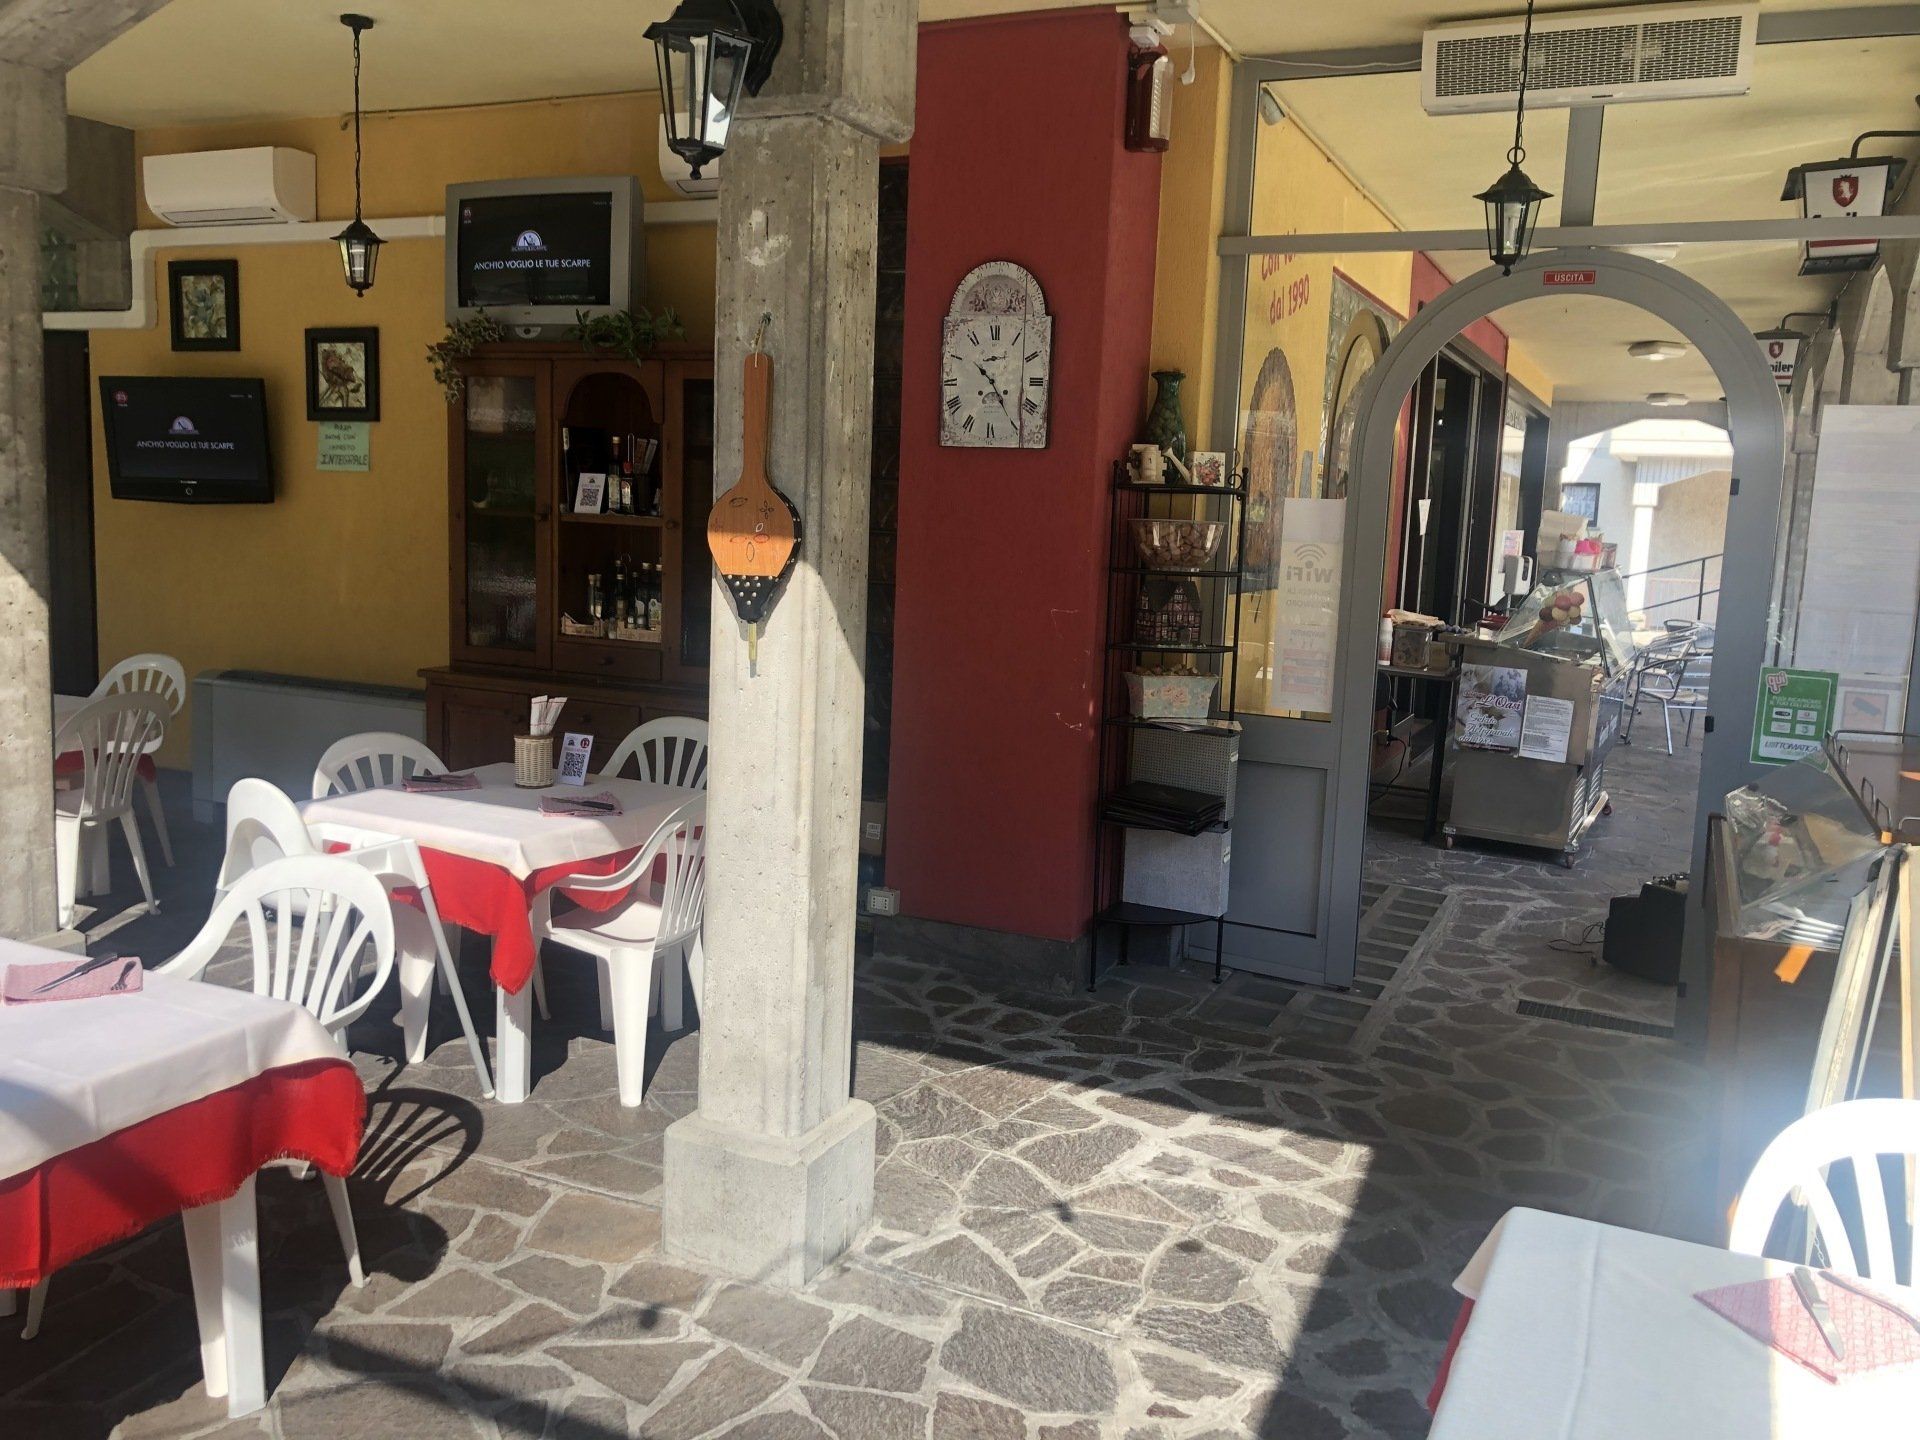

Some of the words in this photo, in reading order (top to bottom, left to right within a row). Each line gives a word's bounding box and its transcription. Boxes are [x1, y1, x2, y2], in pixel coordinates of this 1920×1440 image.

[505, 260, 534, 269] VOGLIO
[545, 260, 559, 268] TUE
[561, 259, 591, 268] SCARPE
[1554, 273, 1584, 282] USCITA
[1269, 287, 1285, 326] dal
[1288, 273, 1310, 316] 1990
[166, 441, 190, 449] VOGLIO
[191, 441, 198, 449] LE
[211, 442, 234, 450] SCARPE
[320, 453, 368, 466] INTEGRALE
[1768, 672, 1787, 692] qui
[1475, 695, 1522, 710] L'Oasi
